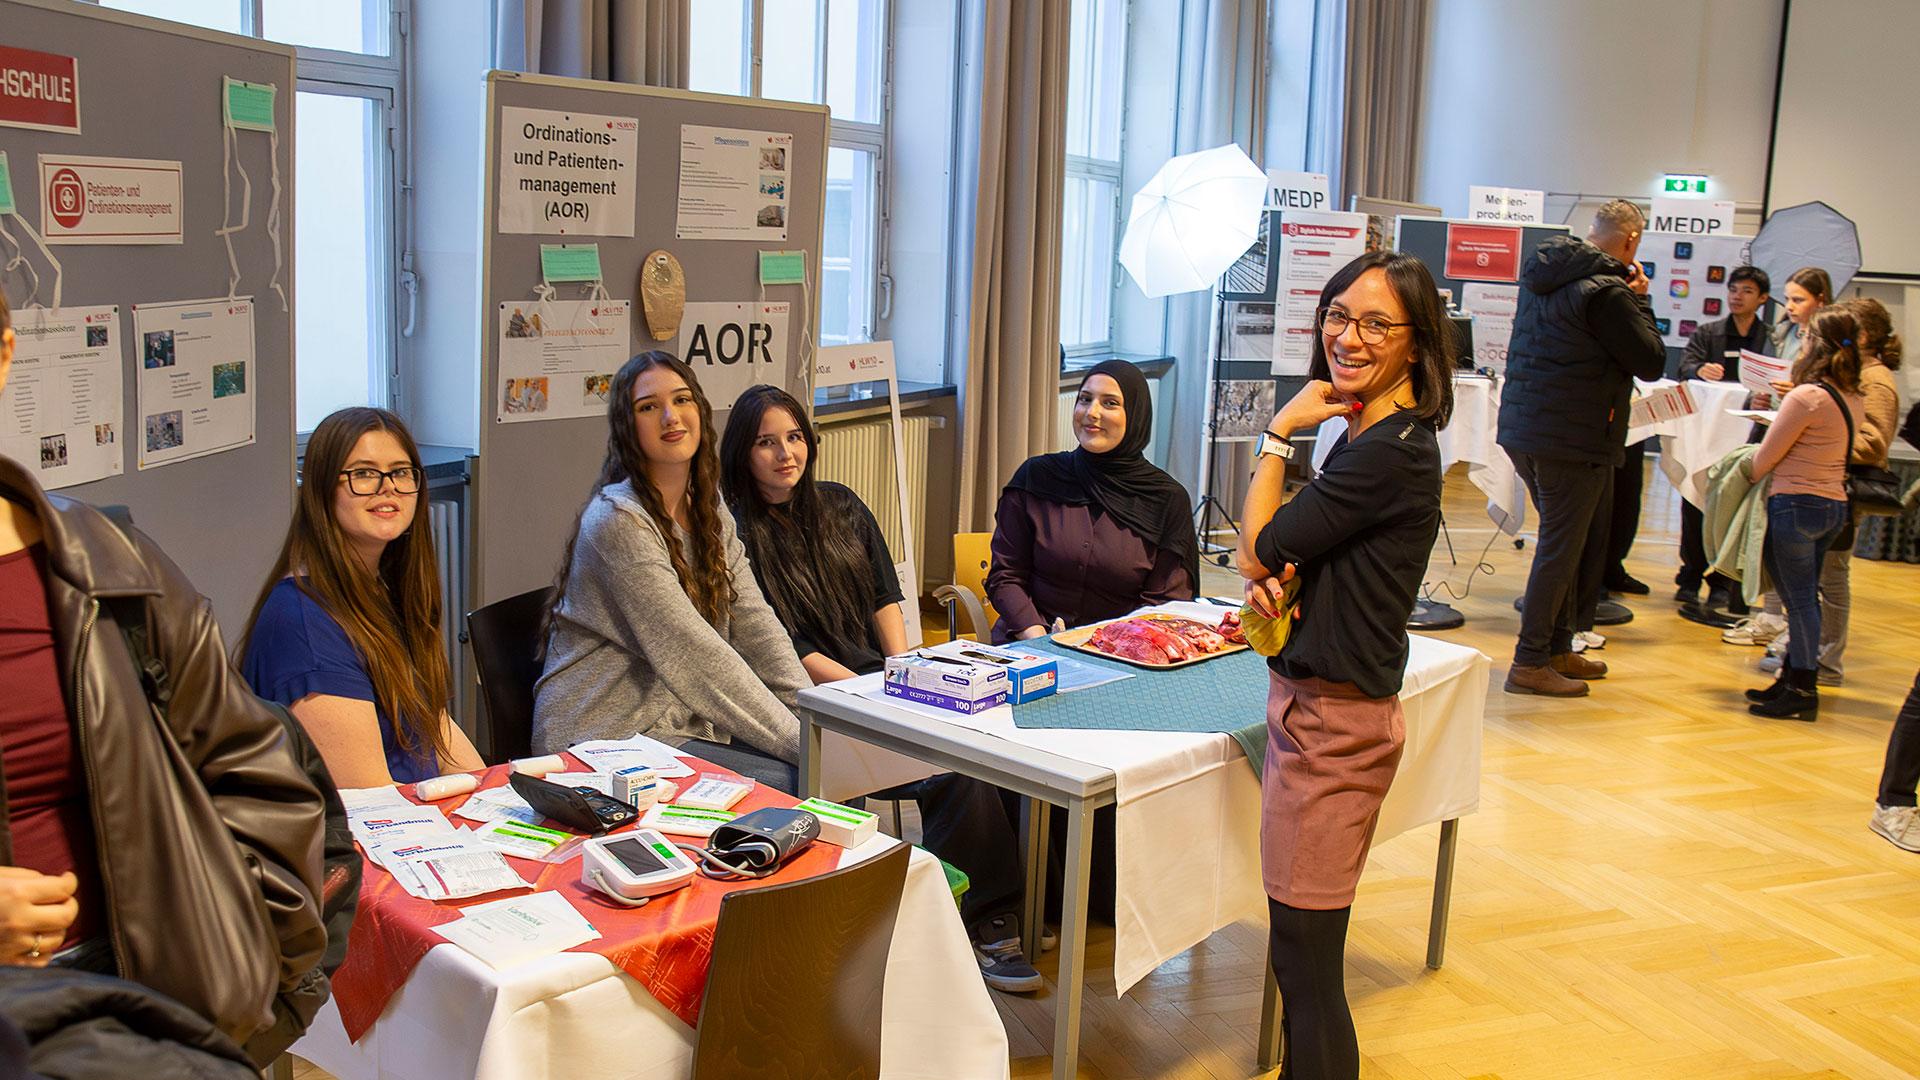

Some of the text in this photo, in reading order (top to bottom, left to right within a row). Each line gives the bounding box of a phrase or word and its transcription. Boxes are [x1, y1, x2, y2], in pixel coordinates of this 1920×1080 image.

[523, 122, 617, 146] Ordinations-
[514, 150, 624, 171] und Patienten-
[87, 181, 141, 197] Patienten- und
[519, 178, 617, 197] management
[1274, 188, 1324, 208] MEDP
[1486, 194, 1527, 206] Meien-
[88, 199, 172, 218] Ordinationsmanagement
[544, 201, 590, 222] (AOR)
[1655, 216, 1721, 234] MEDP
[685, 323, 773, 366] AOR
[886, 684, 902, 695] Large
[995, 693, 1006, 704] 100
[954, 700, 970, 711] 100
[973, 701, 986, 712] Large
